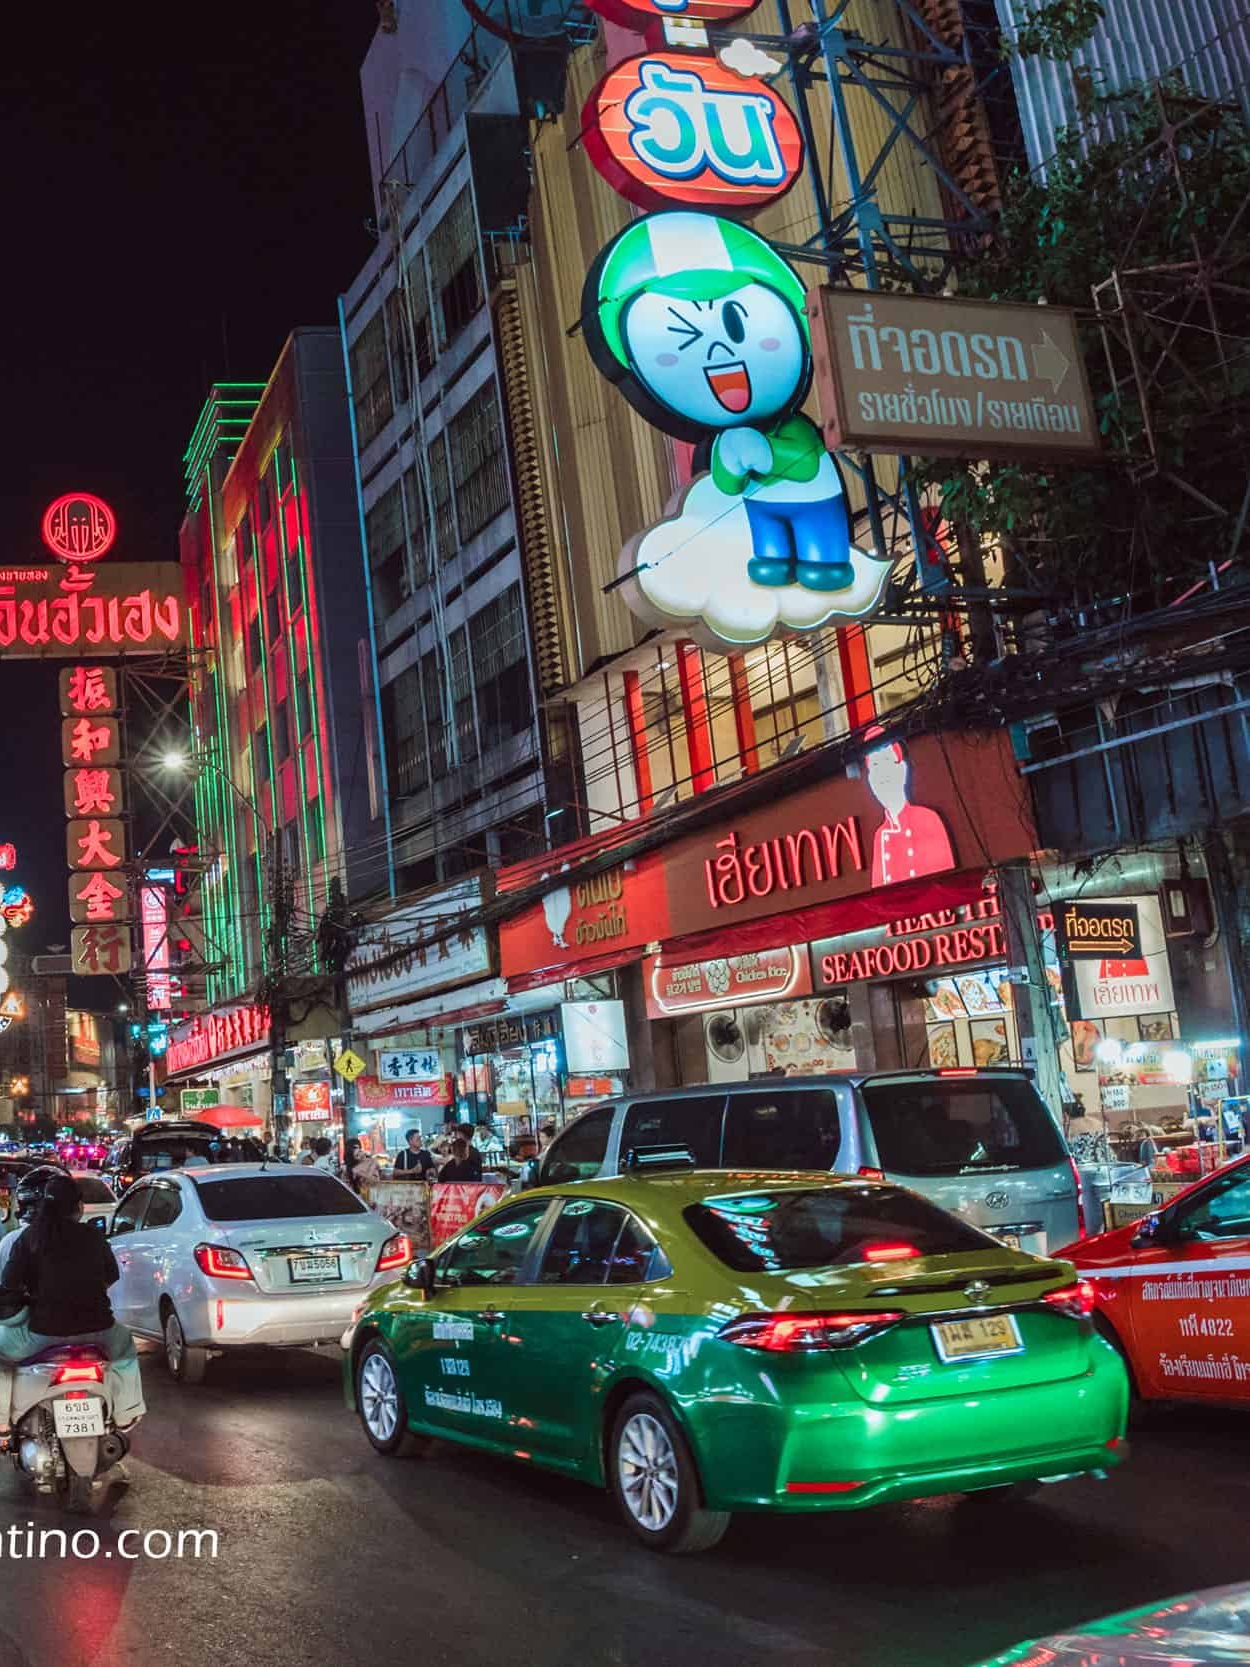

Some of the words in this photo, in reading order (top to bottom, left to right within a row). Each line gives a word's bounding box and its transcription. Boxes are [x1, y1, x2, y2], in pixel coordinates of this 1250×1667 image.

[705, 815, 862, 908] เฮียเทพ
[1065, 906, 1135, 937] ที่จอดรถ
[822, 936, 931, 984] SEAFOOD
[934, 922, 1006, 965] REST
[1093, 980, 1160, 1005] เฮียเทพ
